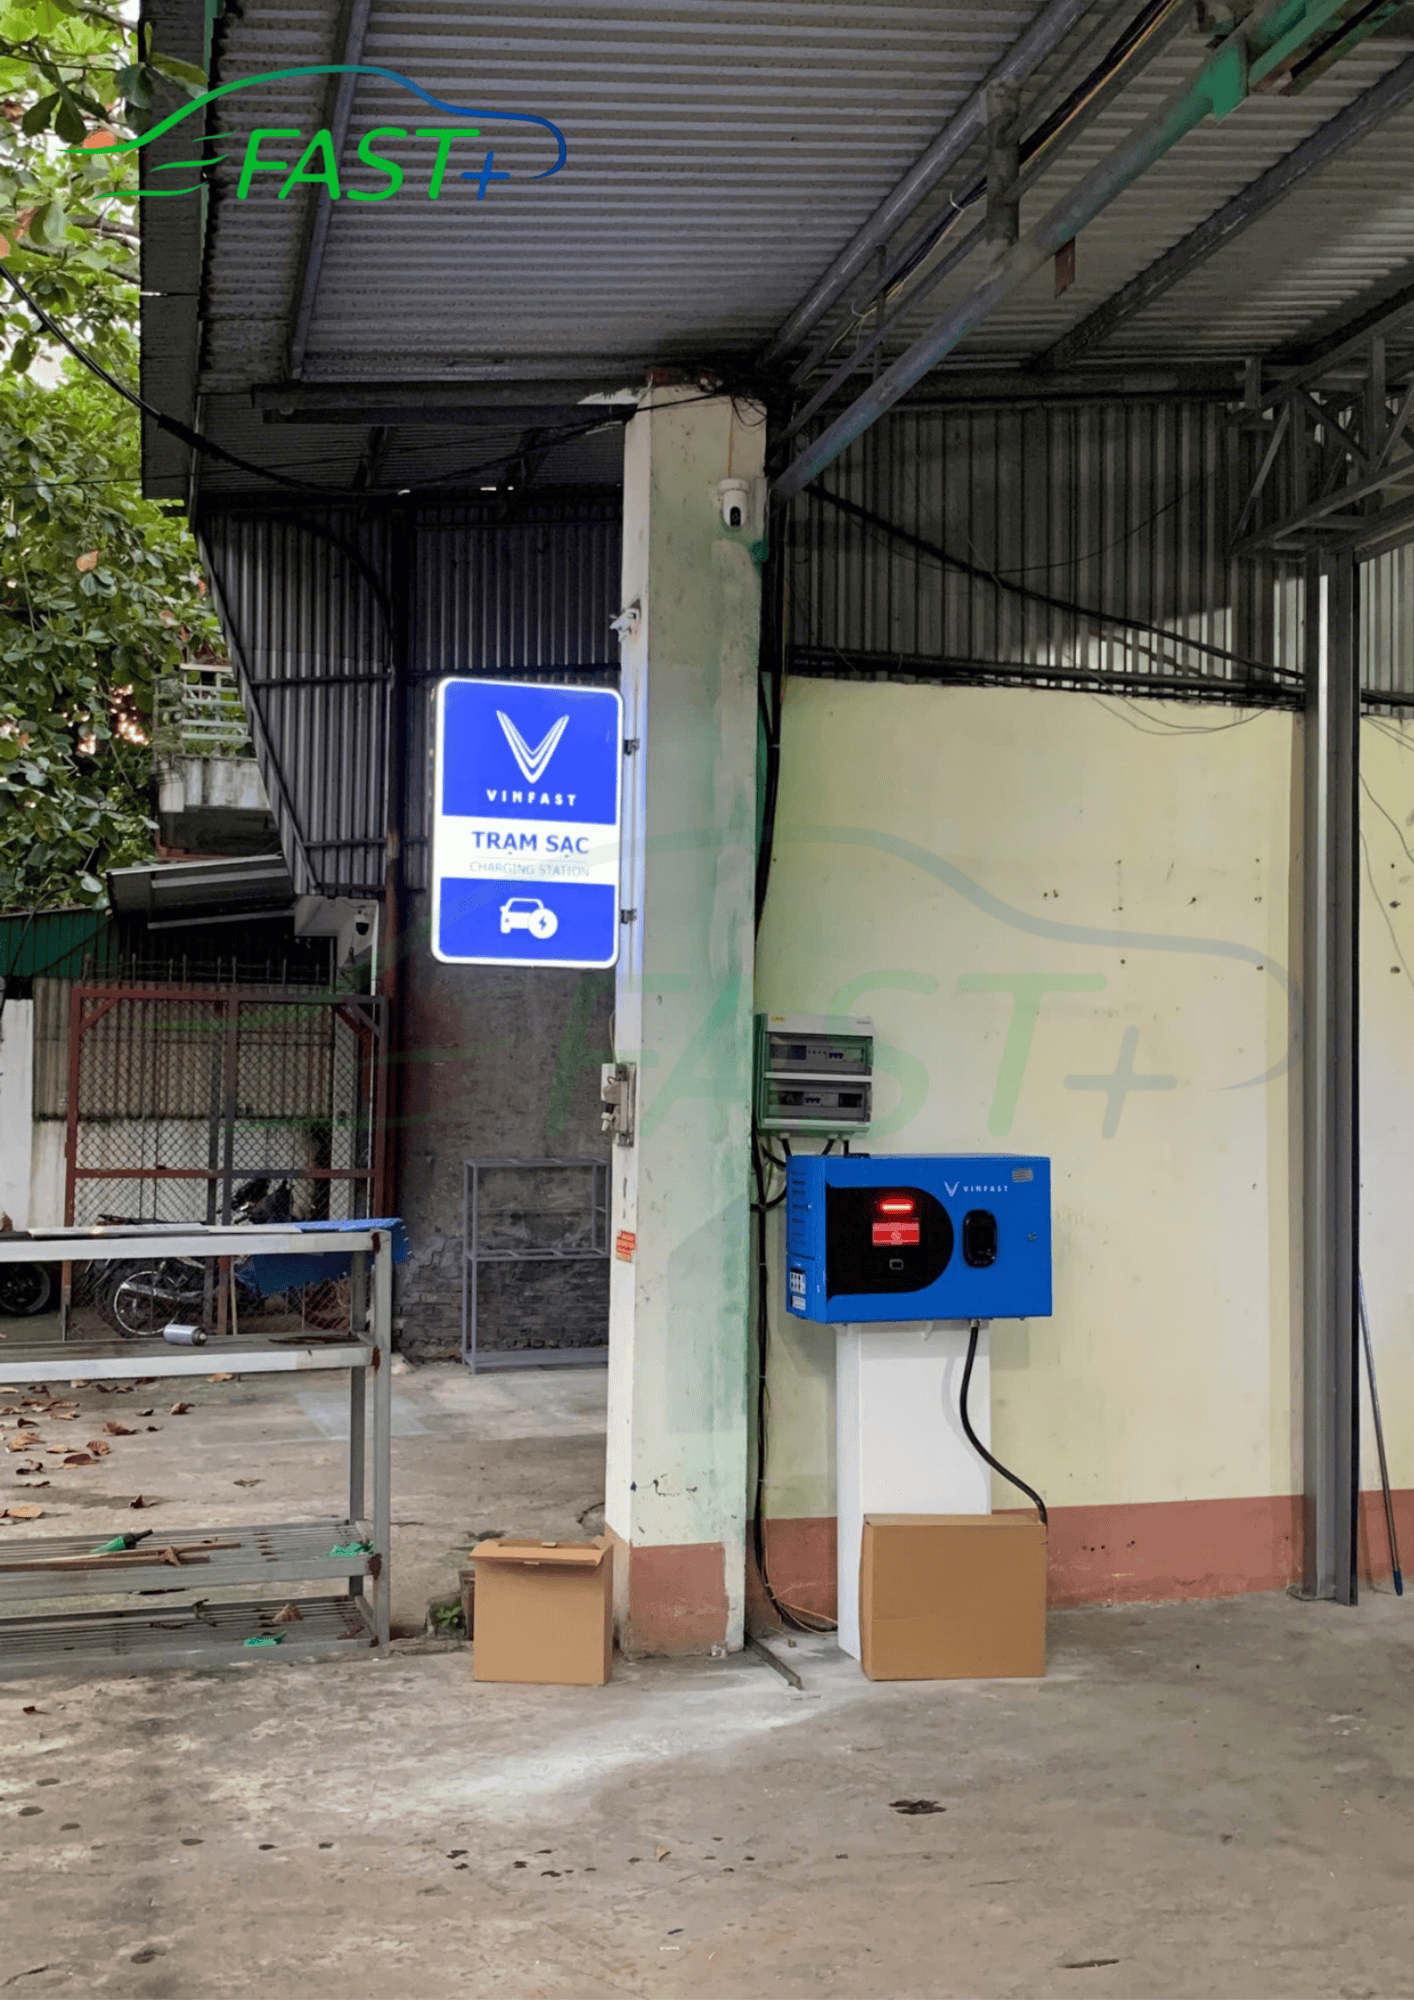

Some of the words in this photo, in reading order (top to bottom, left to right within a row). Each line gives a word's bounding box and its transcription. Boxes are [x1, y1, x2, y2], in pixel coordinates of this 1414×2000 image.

[486, 789, 577, 806] VINFAST
[471, 830, 538, 856] TRẠM
[545, 834, 590, 859] SẠC
[469, 860, 535, 876] CHARGING
[538, 863, 590, 878] STATION
